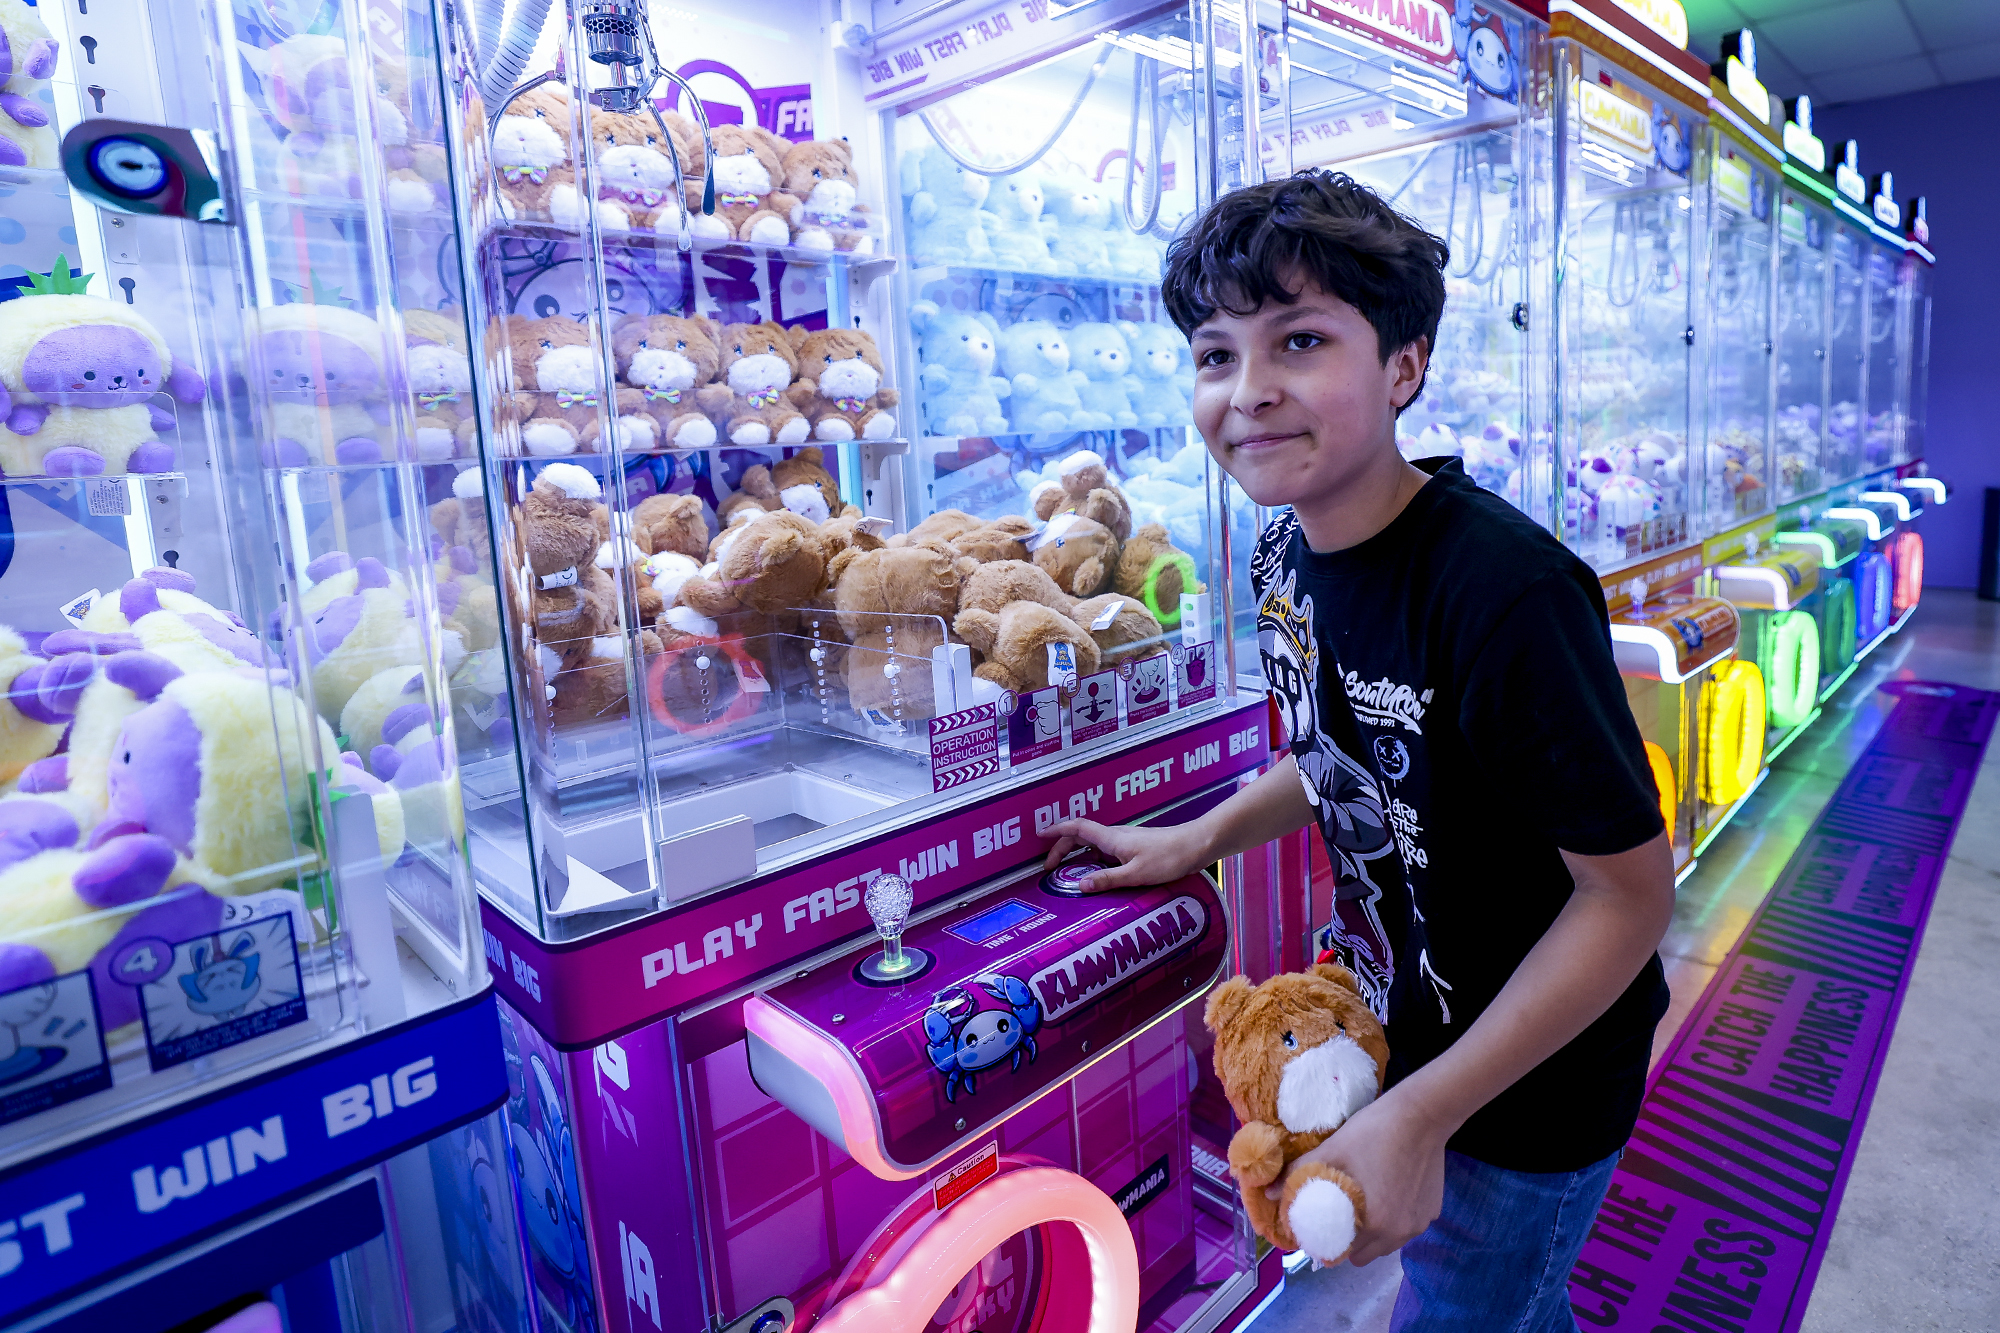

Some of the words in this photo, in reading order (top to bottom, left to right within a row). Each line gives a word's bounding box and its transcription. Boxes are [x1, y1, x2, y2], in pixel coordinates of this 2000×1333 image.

[1067, 678, 1078, 694] 2
[1122, 662, 1132, 678] 3
[1003, 695, 1013, 712] 1
[932, 728, 994, 755] OPERATION
[933, 740, 996, 769] INSTRUCTION
[641, 912, 763, 989] PLAY
[783, 868, 883, 934] FAST
[899, 840, 959, 886] WIN
[972, 815, 1021, 859] BIG
[1034, 784, 1104, 835] PLAY
[1115, 757, 1174, 803] FAST
[1183, 742, 1220, 774] WIN
[1229, 725, 1259, 756] BIG
[983, 933, 1014, 950] TIME
[1020, 913, 1058, 933] ROUND
[122, 946, 158, 972] 4
[509, 950, 542, 1004] BIG
[1036, 904, 1197, 1015] KLAWMANIA
[1730, 964, 1796, 1004] THE
[1690, 1001, 1776, 1077] CATCH
[1769, 980, 1870, 1106] HAPPINESS
[131, 1114, 288, 1214] WIN
[321, 1055, 438, 1138] BIG
[957, 1154, 985, 1175] Caution
[1586, 1183, 1678, 1262] THE
[1567, 1258, 1637, 1333] CH
[1650, 1217, 1777, 1333] INESS
